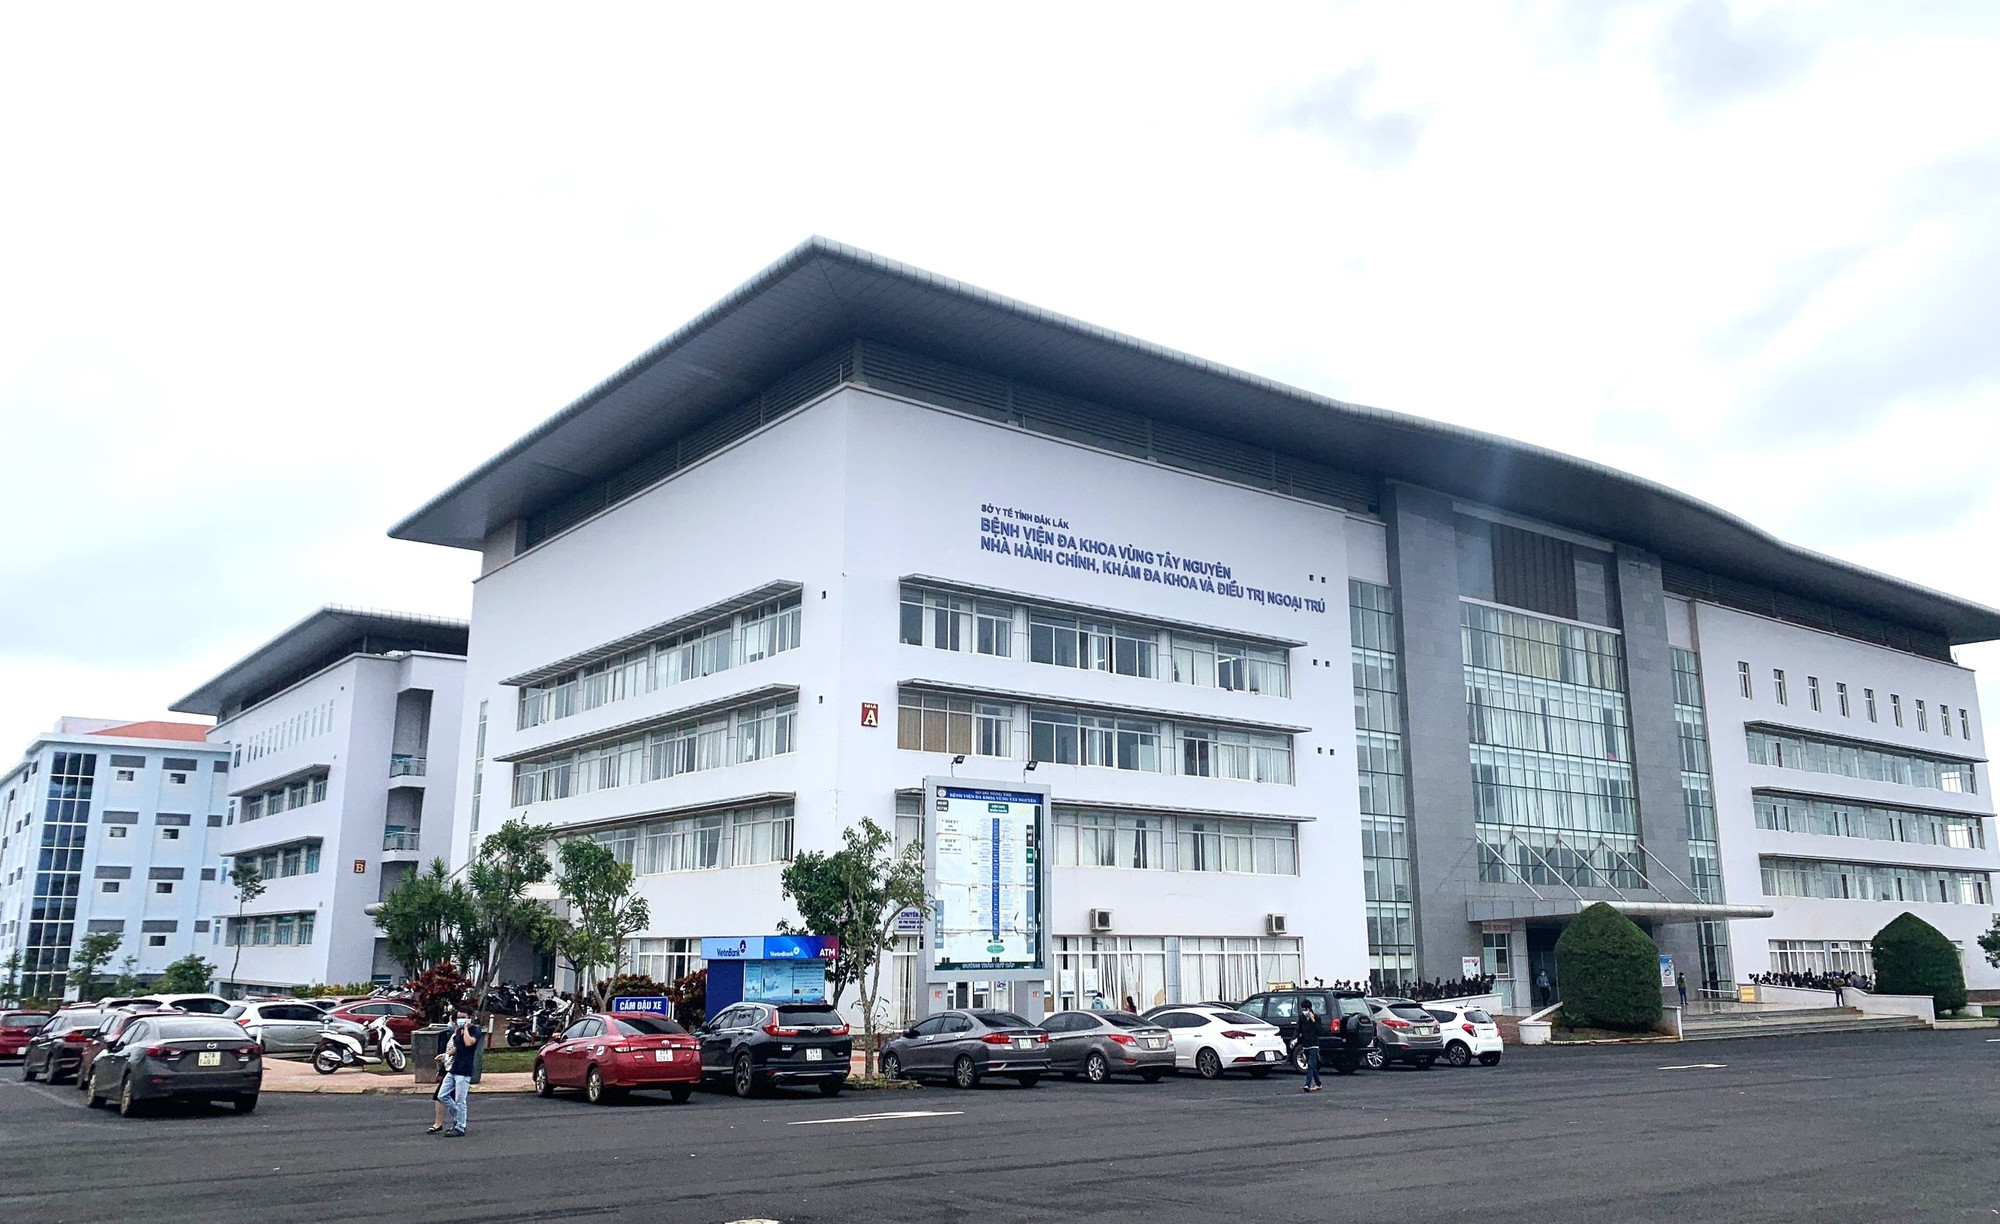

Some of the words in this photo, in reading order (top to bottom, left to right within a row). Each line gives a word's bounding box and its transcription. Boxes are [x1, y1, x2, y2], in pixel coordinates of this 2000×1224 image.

[981, 503, 994, 513] SỞ
[995, 506, 1002, 515] Y
[1002, 507, 1013, 518] TẾ
[1014, 509, 1033, 522] TỈNH
[980, 516, 1020, 538] BỆNH
[1022, 525, 1054, 547] VIỆN
[1057, 533, 1077, 550] ĐA
[1079, 538, 1117, 558] KHOA
[1118, 543, 1155, 564] VÙNG
[1156, 551, 1181, 570] TÂY
[1182, 558, 1231, 580] NGUYÊN
[980, 535, 1011, 555] NHÀ
[1014, 541, 1053, 563] HÀNH
[1055, 551, 1100, 574] CHÍNH,
[1102, 560, 1141, 580] KHÁM
[1143, 568, 1162, 584] ĐA
[1163, 571, 1198, 591] KHOA
[1199, 576, 1215, 594] VÀ
[1246, 587, 1265, 606] TRỊ
[1267, 591, 1302, 612] NGOẠI
[1304, 597, 1326, 613] TRÚ
[863, 709, 878, 726] A
[356, 863, 364, 873] B
[716, 947, 741, 957] VietinBank
[769, 949, 794, 957] VietinBank
[819, 948, 836, 957] ATM
[619, 999, 636, 1010] CẤM
[637, 999, 652, 1012] ĐẬU
[652, 1001, 662, 1010] XE
